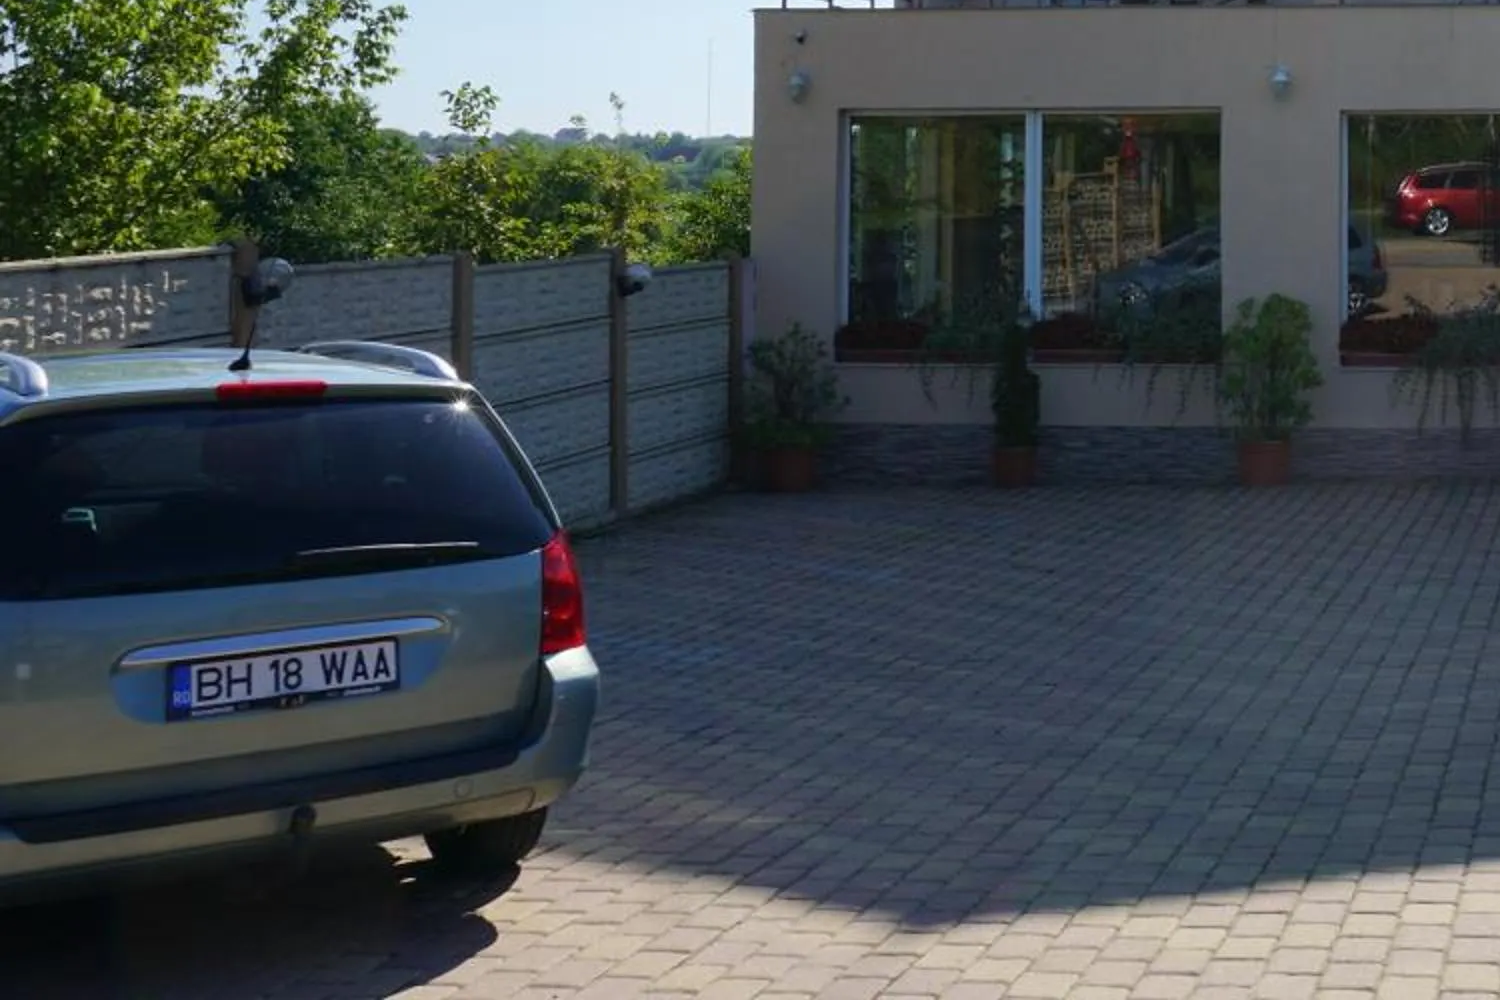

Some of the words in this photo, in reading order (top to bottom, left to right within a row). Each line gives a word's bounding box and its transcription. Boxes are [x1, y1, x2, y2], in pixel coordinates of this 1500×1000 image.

[196, 662, 252, 702] BH
[269, 657, 303, 692] 18
[319, 647, 391, 685] WAA
